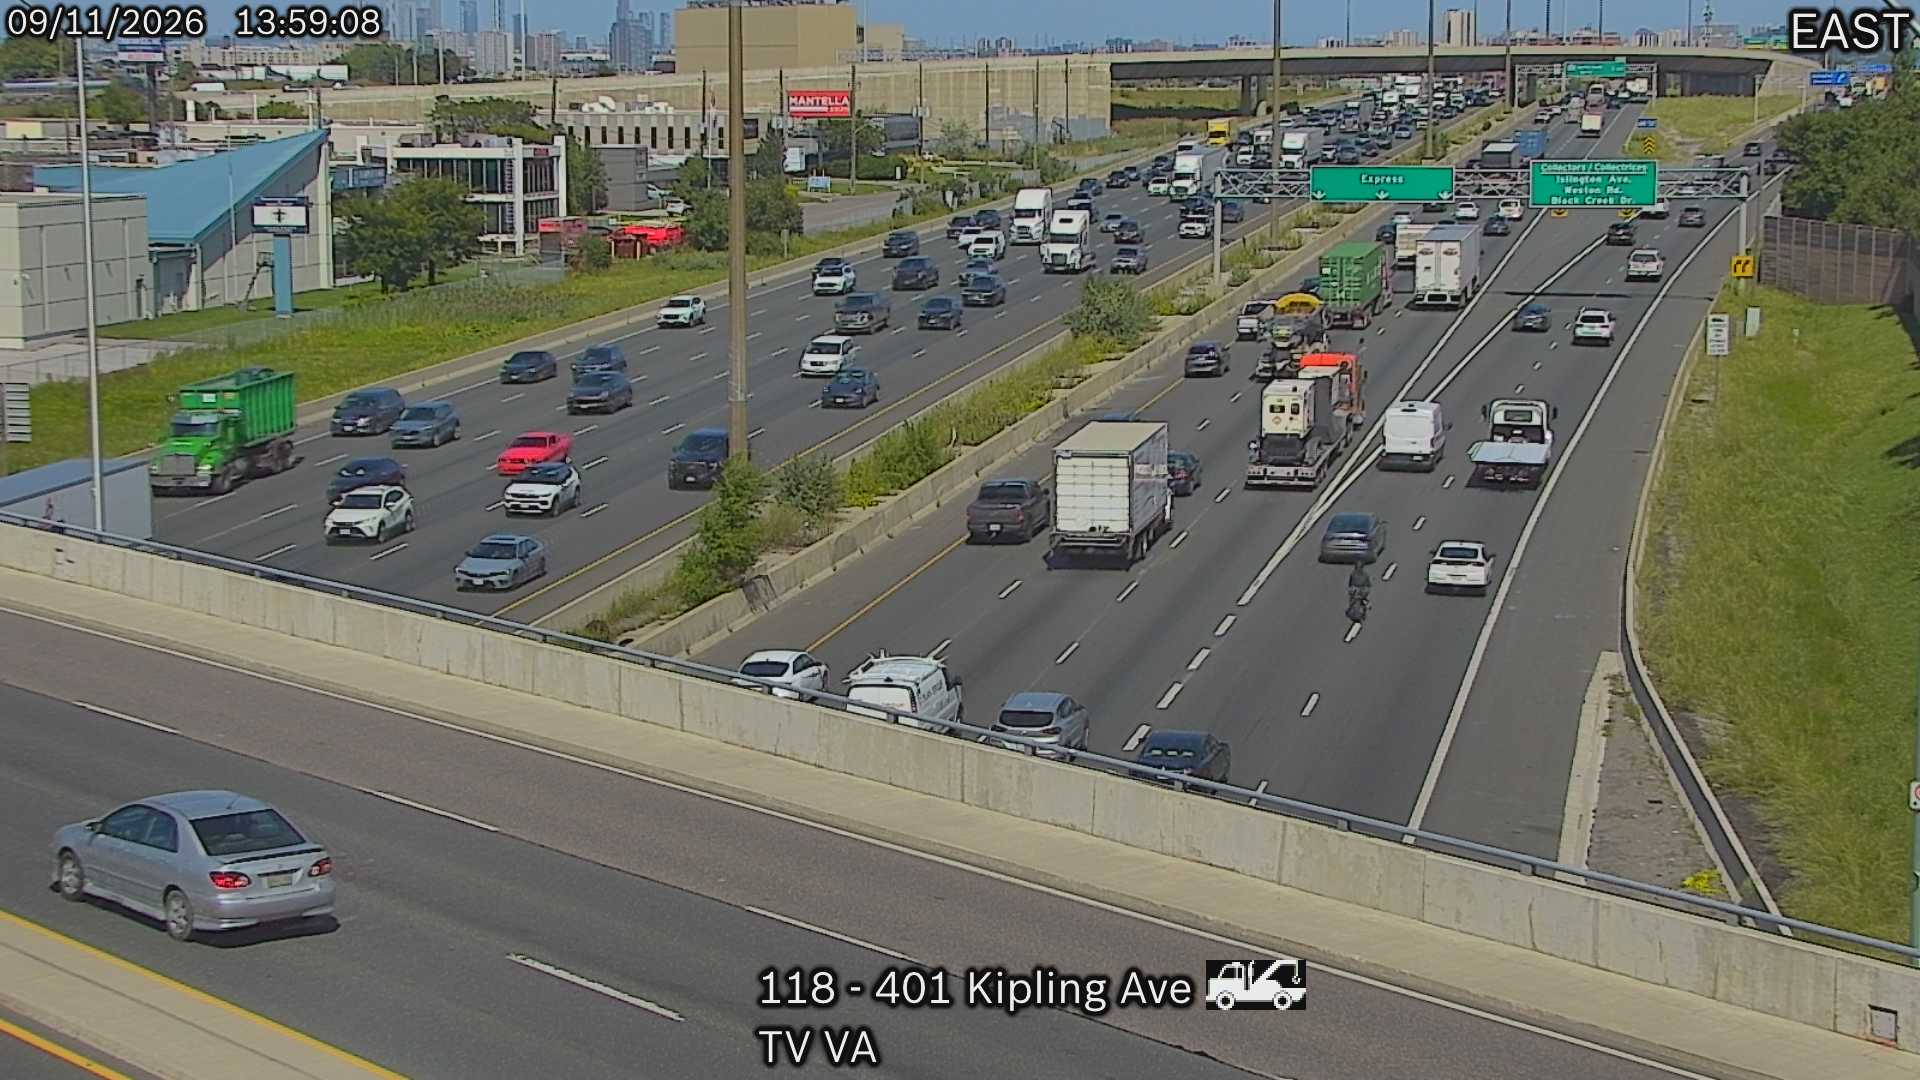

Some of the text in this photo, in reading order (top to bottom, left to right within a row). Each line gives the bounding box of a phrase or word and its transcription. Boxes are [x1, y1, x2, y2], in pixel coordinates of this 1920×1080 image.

[789, 95, 849, 106] MANTELLA
[1541, 163, 1586, 172] Collectors
[1361, 174, 1404, 185] Express
[1555, 175, 1632, 185] Islington Ave.
[1564, 186, 1624, 194] Weston Rd.
[1551, 196, 1580, 205] Black
[1585, 196, 1615, 205] Creek
